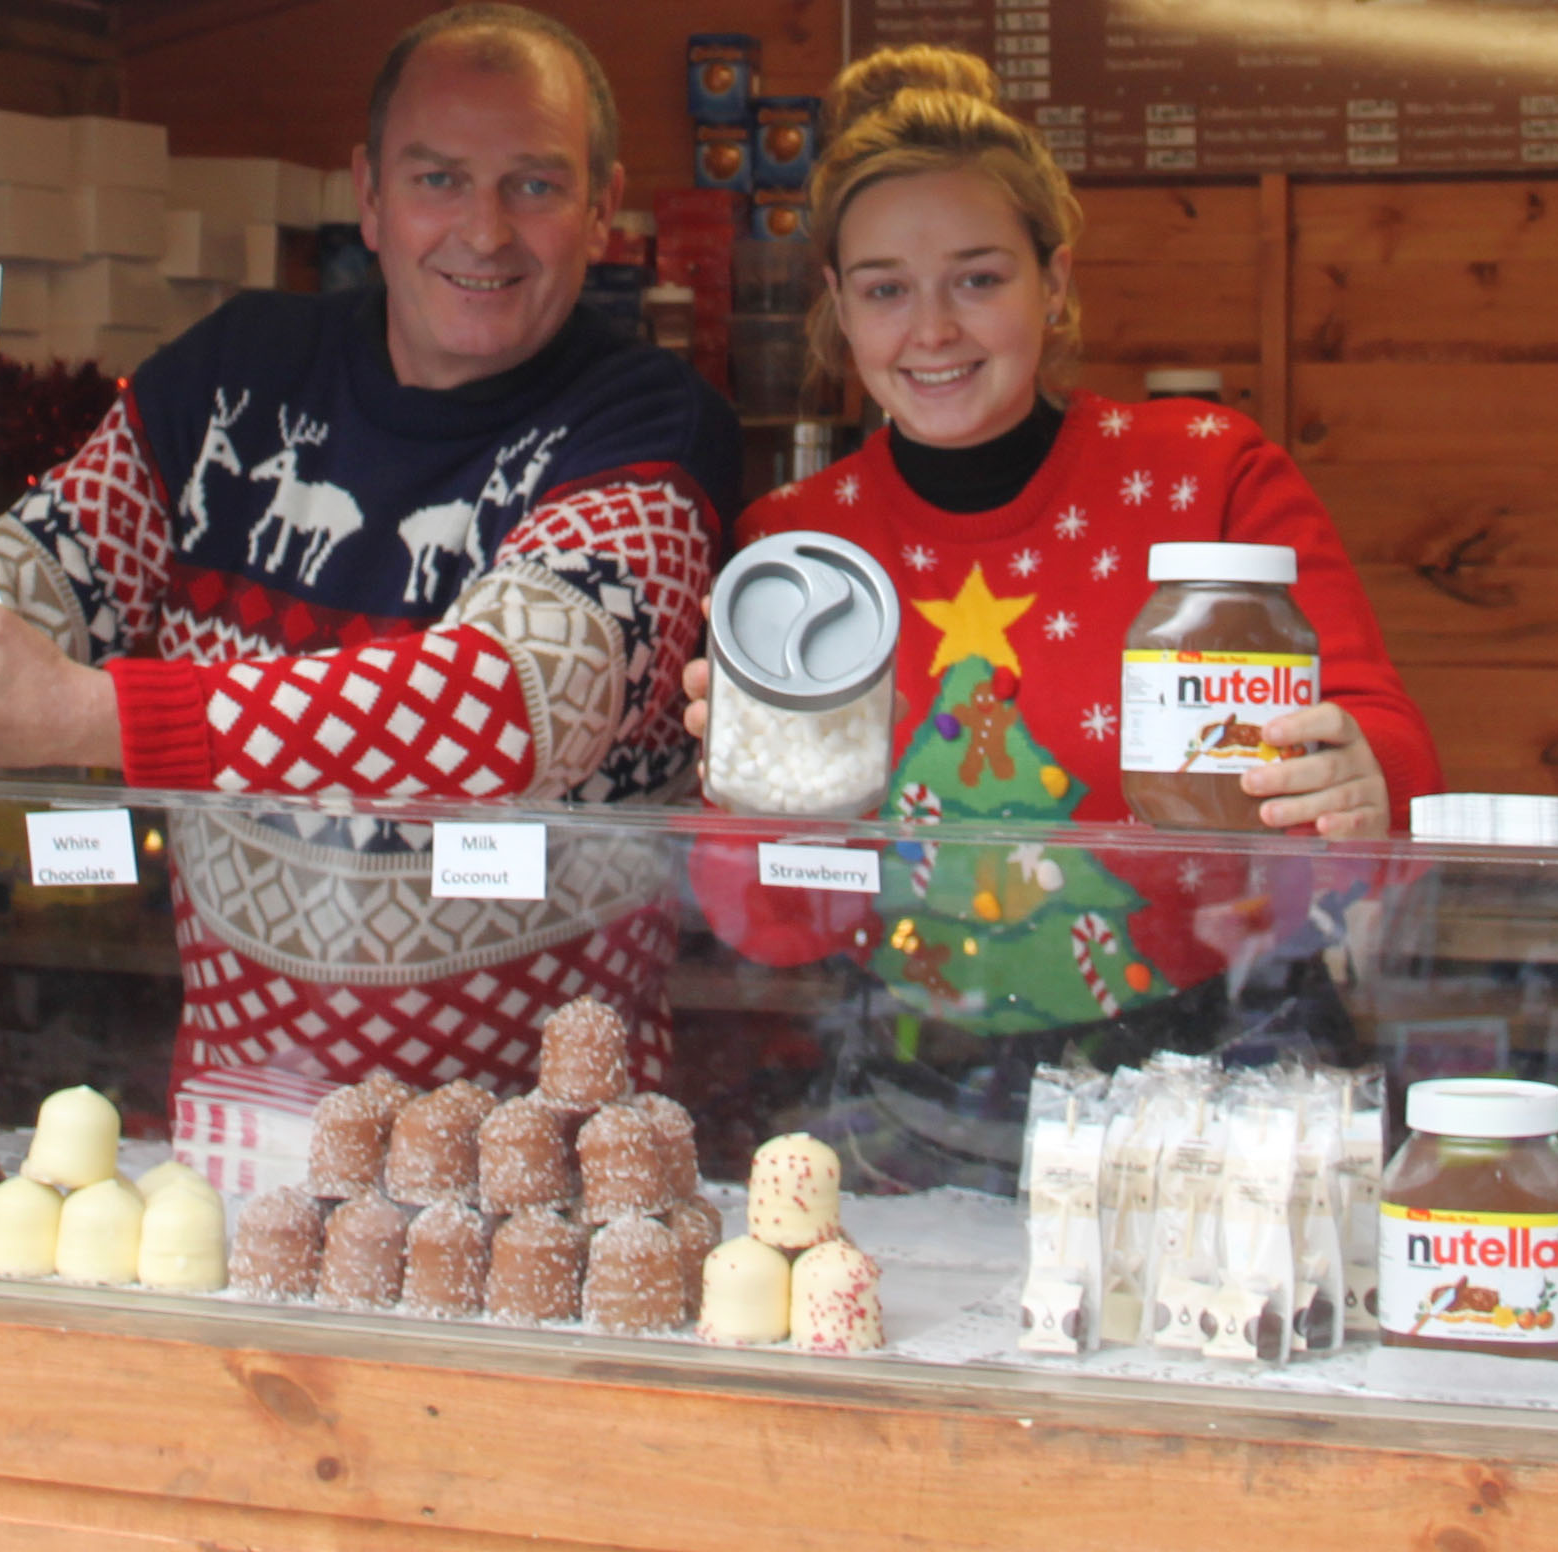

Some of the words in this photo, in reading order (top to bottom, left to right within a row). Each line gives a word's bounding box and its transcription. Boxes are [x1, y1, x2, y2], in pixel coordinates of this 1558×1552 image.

[1177, 666, 1313, 706] nutella
[52, 836, 100, 851] White
[461, 835, 498, 850] Milk
[38, 866, 116, 883] Chocolate
[440, 868, 509, 885] Coconut
[769, 861, 868, 886] Strawberry
